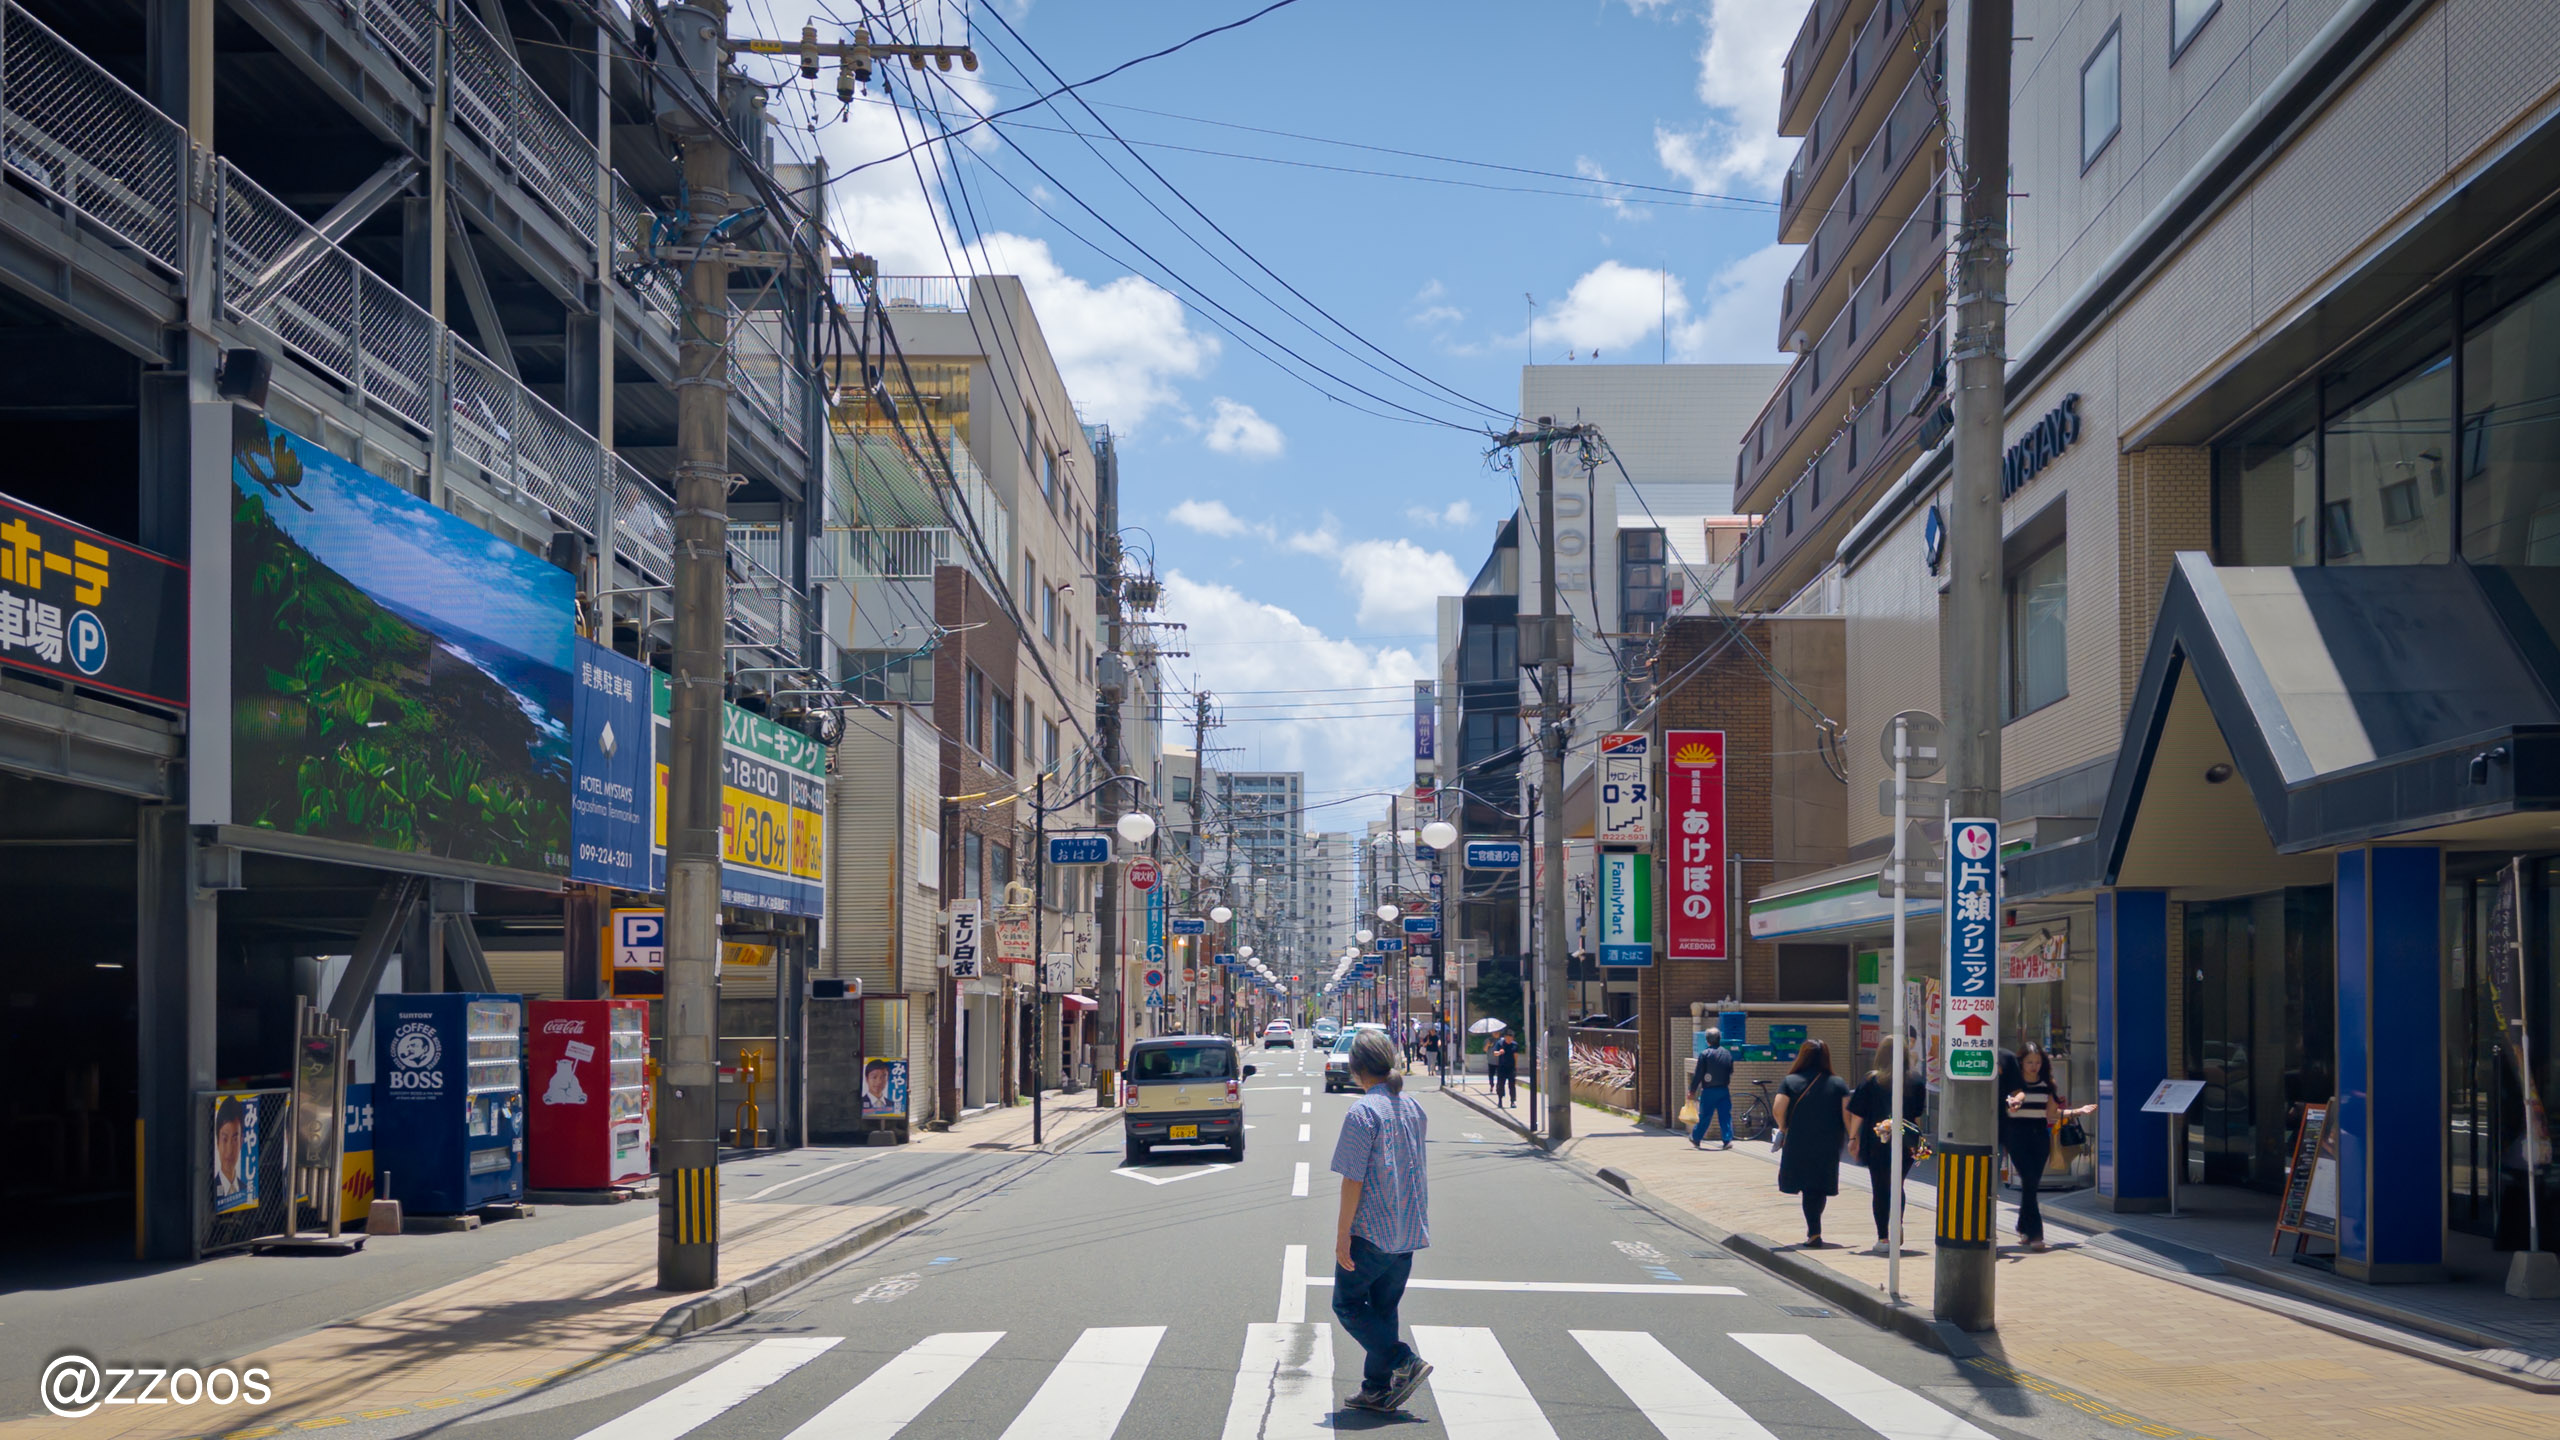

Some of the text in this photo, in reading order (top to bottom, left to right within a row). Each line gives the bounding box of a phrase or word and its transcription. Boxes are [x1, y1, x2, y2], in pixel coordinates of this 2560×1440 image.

[1556, 420, 1588, 591] HOUS
[78, 619, 99, 662] P
[581, 661, 633, 703] 提携駐車場
[722, 705, 819, 770] Xパーキング
[1603, 736, 1624, 745] パーマ
[1625, 744, 1646, 753] カット
[1610, 771, 1639, 781] サロンド
[580, 774, 633, 804] HOTEL MYSTAYS
[571, 792, 608, 817] Kagoshima
[579, 843, 633, 869] 099-224-3211
[1056, 848, 1102, 861] おはし
[1682, 808, 1713, 919] あけぼの
[1610, 861, 1625, 935] FamilyMart
[628, 918, 659, 945] P
[1956, 861, 1992, 993] 片瀬クリニック
[953, 913, 976, 976] モリ白衣
[1621, 951, 1644, 961] たばこ
[1678, 943, 1716, 951] AKEBONO
[624, 951, 661, 964] 入口
[1951, 999, 1994, 1011] 222-2560
[395, 1022, 437, 1038] COFFEE
[1956, 1059, 1989, 1069] 山之口町
[389, 1070, 444, 1090] BOSS
